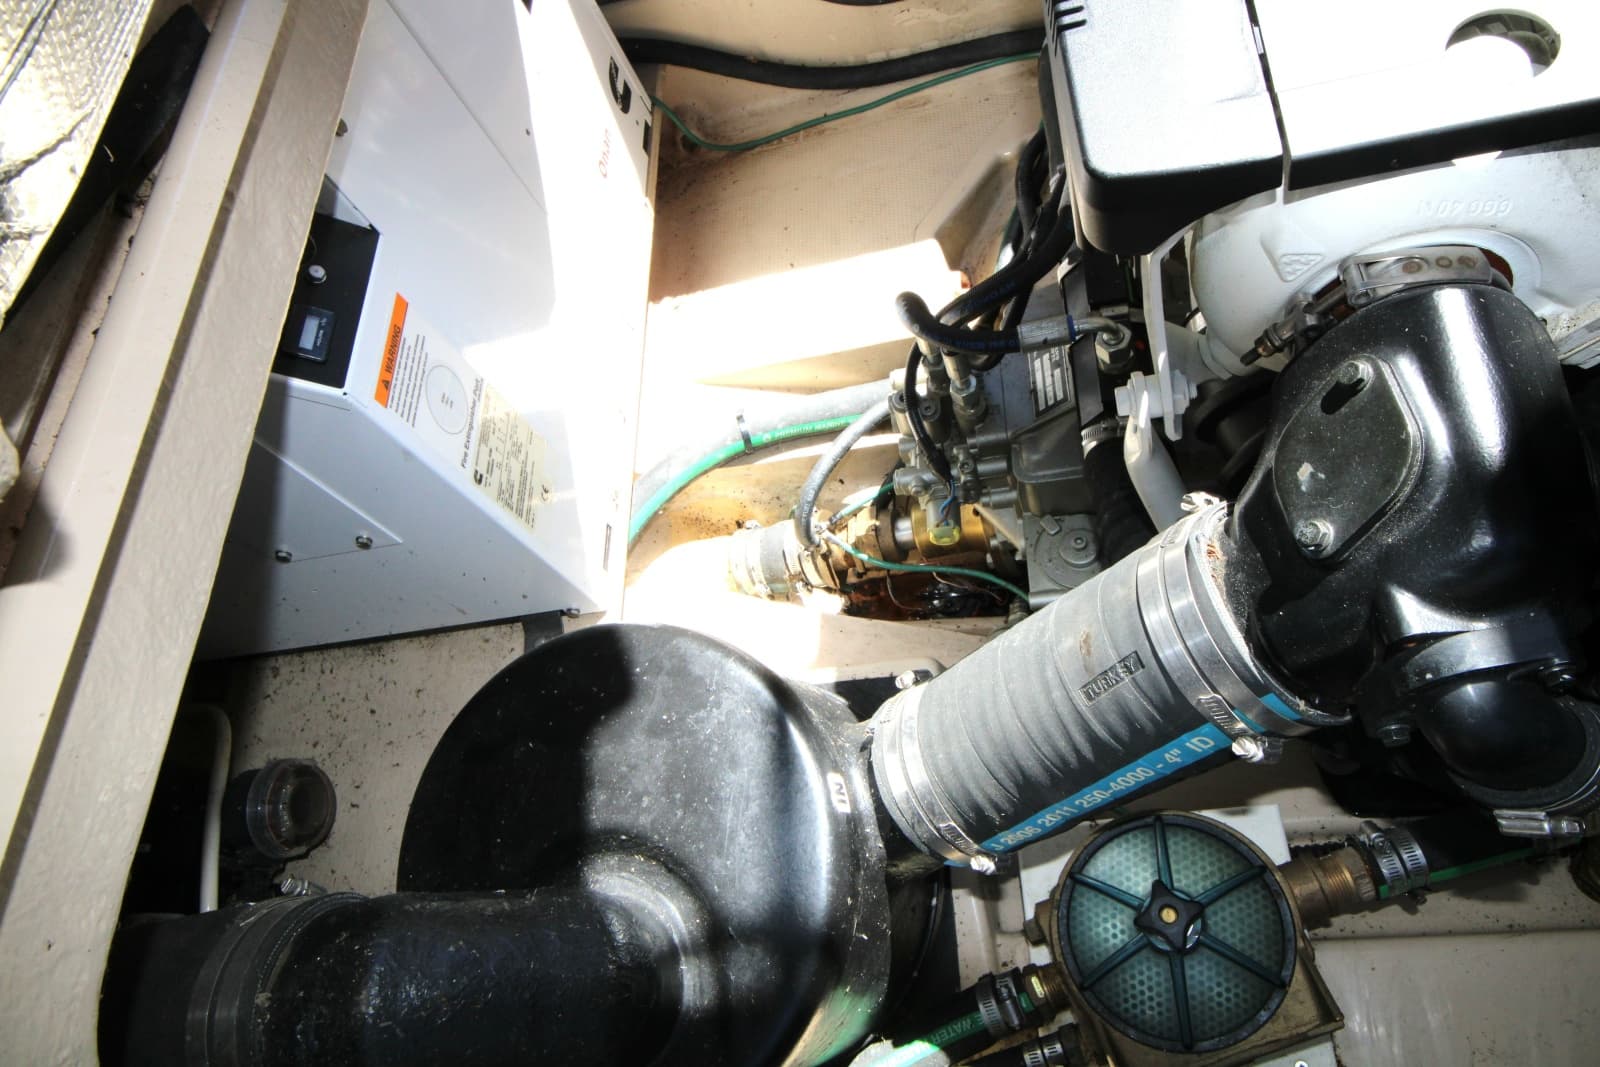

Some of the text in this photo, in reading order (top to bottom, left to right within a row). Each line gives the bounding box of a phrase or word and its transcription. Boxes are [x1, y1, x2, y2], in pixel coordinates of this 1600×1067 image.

[385, 324, 401, 374] WARNING
[464, 399, 477, 450] Extinguisher
[461, 451, 469, 470] Fire
[1083, 654, 1137, 700] TURKEY
[1037, 805, 1078, 827] 2011
[1074, 767, 1155, 809] 250-4000
[1164, 748, 1183, 765] 4"
[1185, 736, 1215, 753] ID
[931, 1018, 974, 1044] WATER
